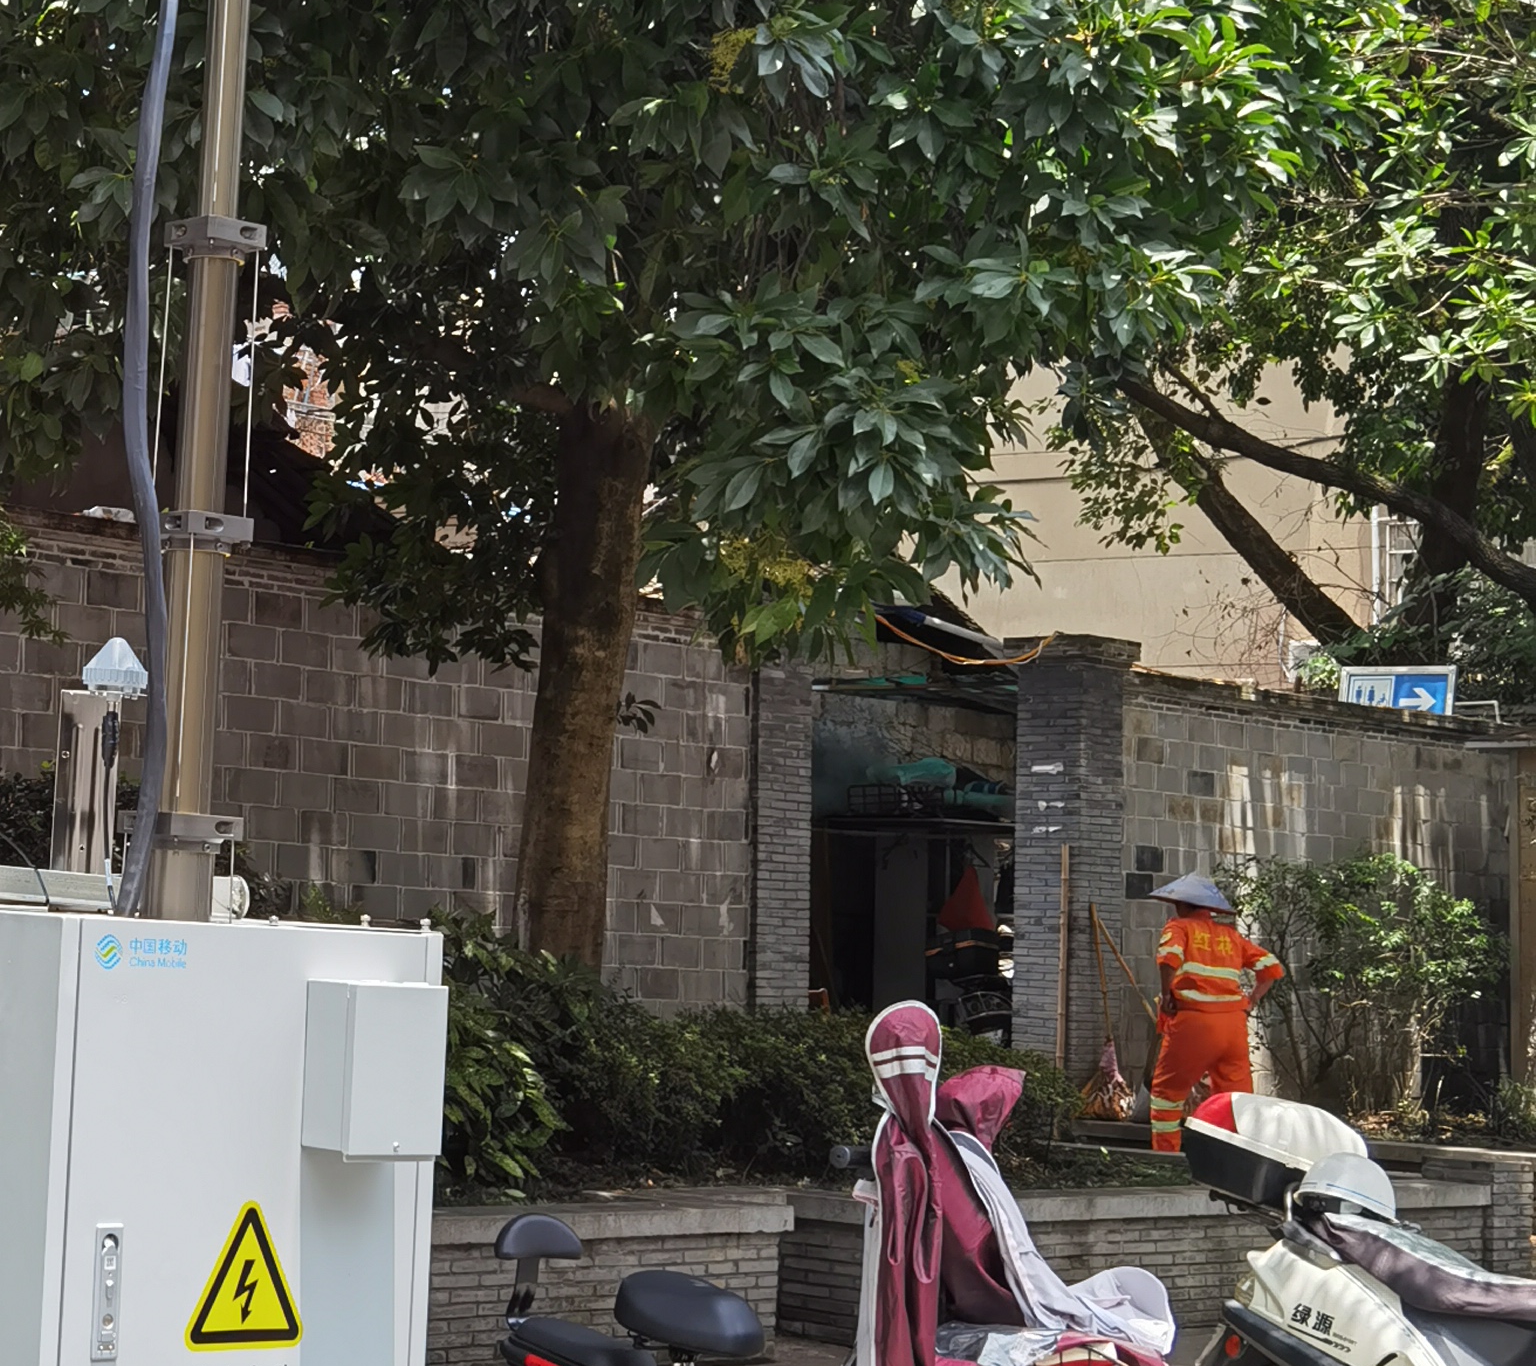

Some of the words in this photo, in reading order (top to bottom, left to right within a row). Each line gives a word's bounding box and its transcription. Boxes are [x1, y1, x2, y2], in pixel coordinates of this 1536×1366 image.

[129, 937, 188, 956] 中国移动
[129, 956, 155, 967] China
[157, 957, 187, 969] Mobile
[1290, 1302, 1335, 1337] 绿源
